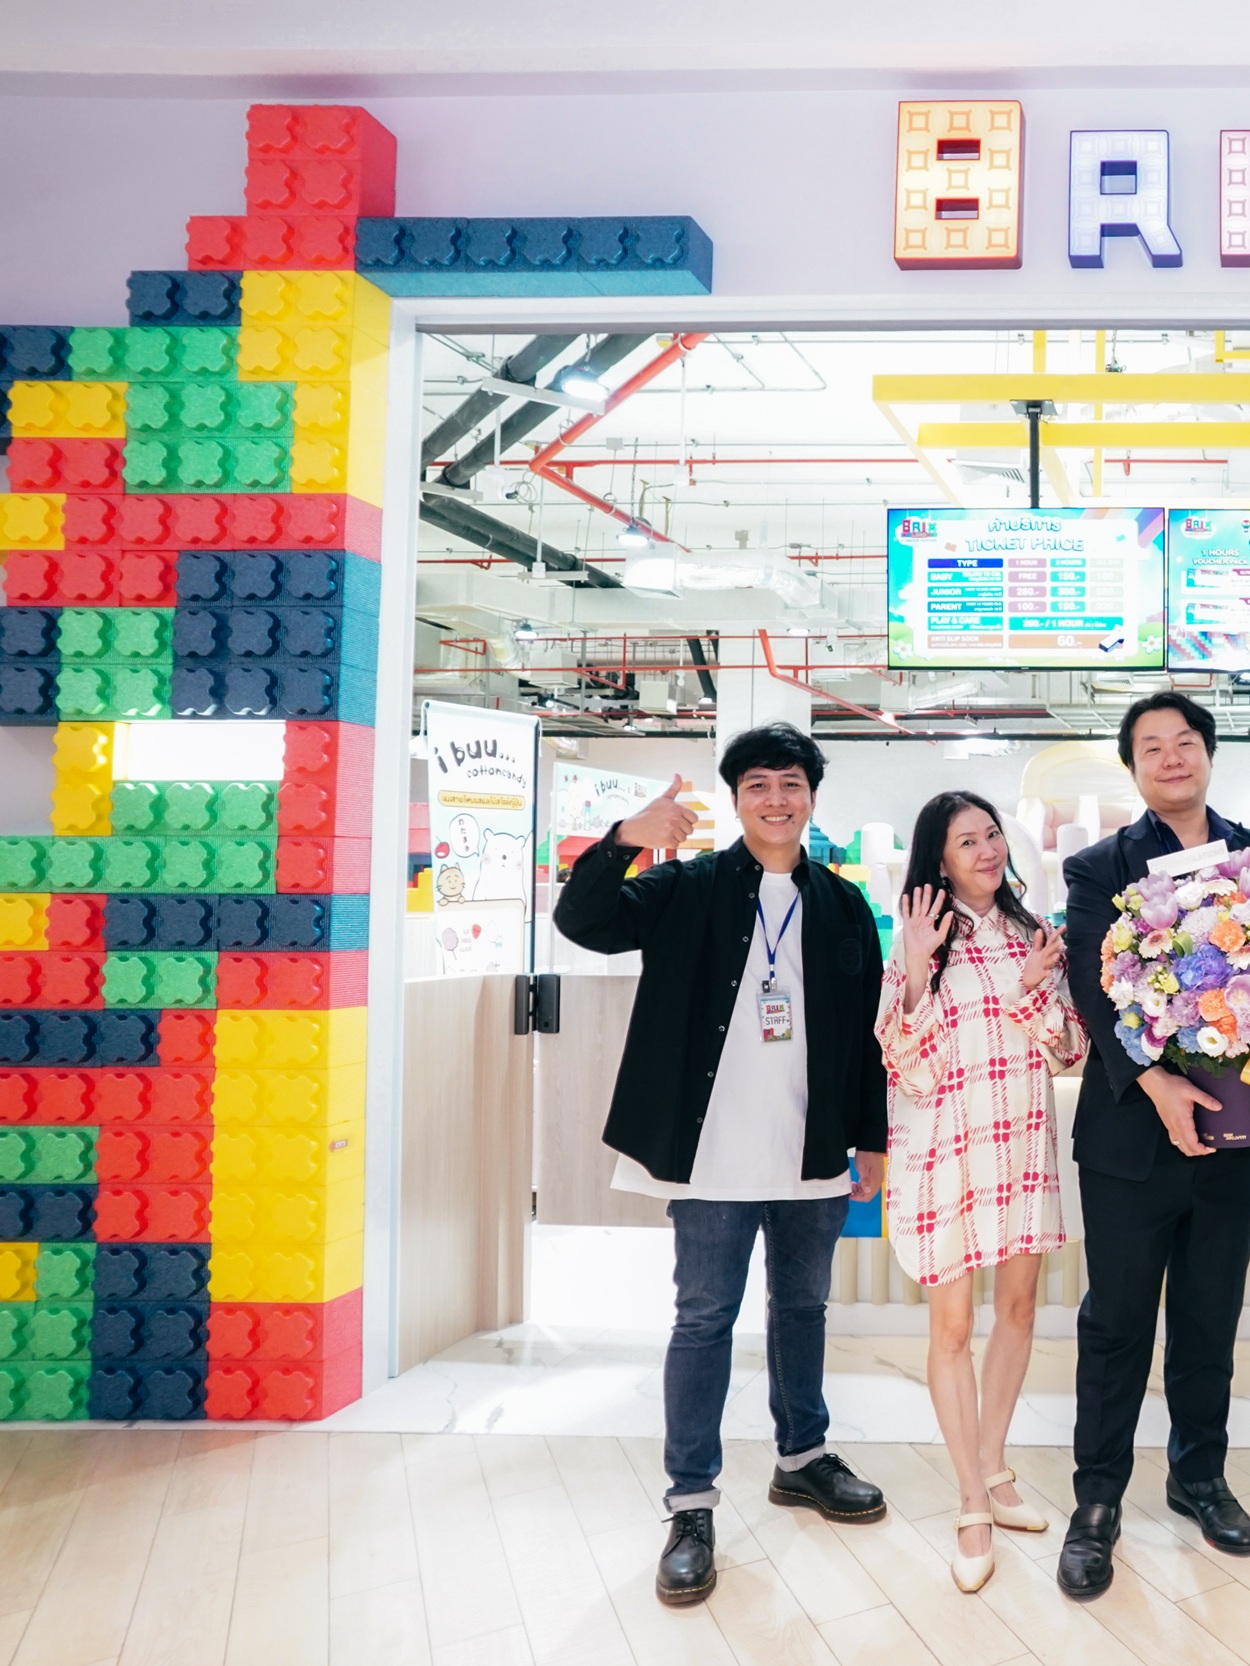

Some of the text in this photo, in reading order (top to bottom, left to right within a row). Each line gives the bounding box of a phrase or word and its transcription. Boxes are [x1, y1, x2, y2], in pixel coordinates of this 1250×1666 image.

[902, 519, 937, 533] BRIX
[965, 536, 1085, 552] TICKET PRICE
[1201, 549, 1240, 557] 1 HOURS
[957, 559, 978, 567] TYPE
[930, 573, 953, 581] BABY
[931, 588, 962, 596] JUNIOR
[930, 603, 962, 611] PARENT
[930, 616, 951, 624] PLAY
[958, 616, 981, 624] CARE
[1058, 619, 1084, 628] HOUR
[1057, 635, 1082, 647] 60.-
[434, 746, 448, 774] i
[467, 765, 527, 789] cottoncandy
[765, 1016, 786, 1025] STAFF
